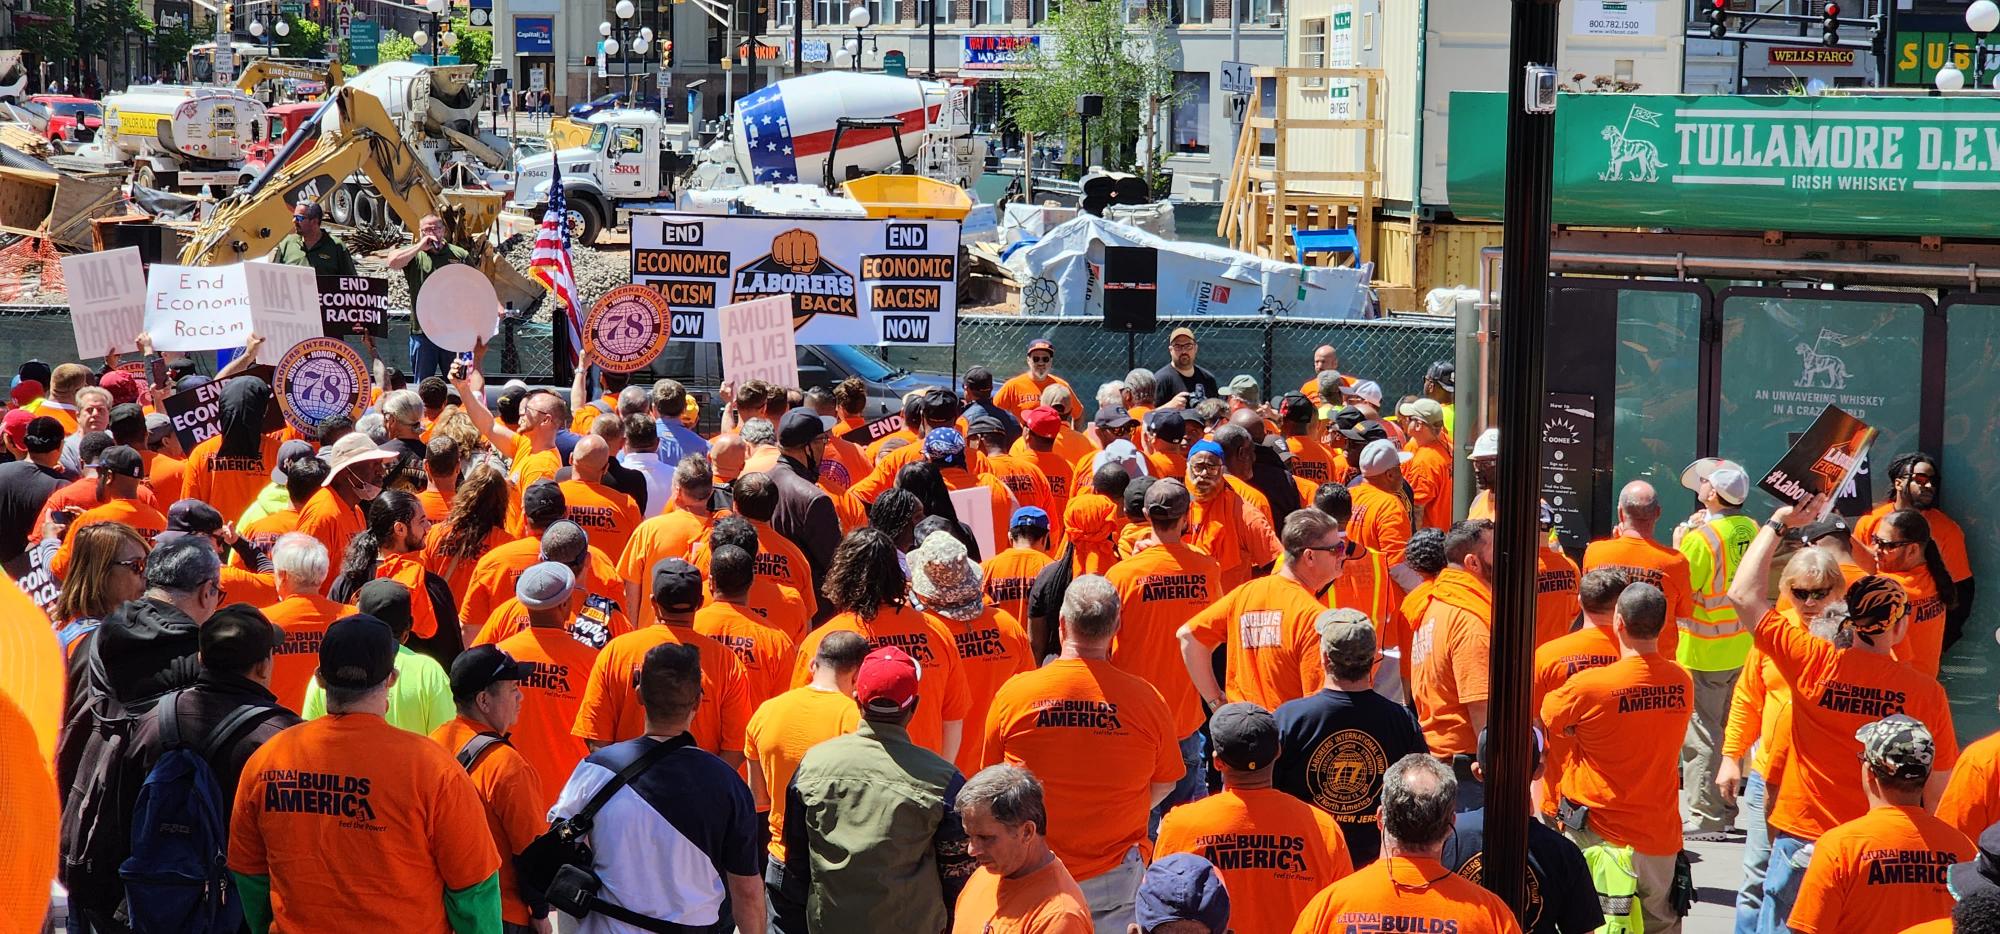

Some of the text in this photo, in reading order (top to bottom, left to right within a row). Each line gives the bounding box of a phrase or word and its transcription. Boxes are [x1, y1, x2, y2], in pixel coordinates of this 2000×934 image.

[1589, 20, 1639, 29] 800.782.1500
[738, 45, 779, 59] DNKIN'
[969, 37, 983, 50] WAY
[987, 37, 994, 50] IN
[1774, 50, 1855, 64] WELLS FARGO
[121, 118, 139, 128] TAYLOR
[1674, 122, 1904, 169] TULLAMORE
[528, 170, 548, 178] 93443
[614, 165, 640, 175] SRM
[297, 179, 321, 201] CAT
[1792, 175, 1908, 192] IRISH WHISKEY
[665, 225, 701, 243] END
[889, 227, 924, 247] END
[637, 252, 728, 274] ECONOMIC
[862, 257, 952, 279] ECONOMIC
[179, 273, 224, 289] End
[339, 277, 369, 291] END
[735, 272, 854, 297] LABORERS
[156, 293, 251, 311] Economic
[612, 294, 635, 305] HONOR
[800, 296, 855, 314] BACK
[873, 288, 938, 309] RACISM
[326, 309, 381, 324] RACISM
[604, 287, 662, 307] INTERNATIONAL
[661, 308, 669, 336] UNION
[175, 320, 244, 337] Racism
[607, 312, 645, 340] 78
[671, 314, 702, 335] OW
[885, 318, 928, 340] NOW
[621, 353, 640, 362] APRIL
[649, 332, 659, 348] 1903
[598, 358, 623, 371] North
[624, 348, 660, 370] America
[287, 350, 359, 394] JUSTICE HONOR STRENGTH
[303, 340, 366, 376] INTERNATIONAL
[358, 378, 369, 409] UNION
[301, 370, 341, 405] 78
[1755, 390, 1885, 407] AN UNWAVERING WHISKEY
[285, 392, 313, 425] ORGANIZED
[1773, 404, 1822, 417] IN A CRAZ
[1815, 459, 1842, 477] FIGHT
[572, 506, 613, 517] BUILDS
[568, 515, 616, 528] ERICA
[756, 552, 788, 565] UILDS
[754, 562, 791, 578] ERICA
[1547, 570, 1575, 581] BUILDS
[1163, 574, 1207, 586] BUILDS
[1538, 580, 1576, 594] MERICA
[1142, 583, 1209, 602] AMERICA
[877, 633, 928, 647] BUILDS
[953, 629, 1000, 645] BUILDS
[271, 640, 320, 655] AMER
[960, 640, 1006, 659] ERICA
[535, 662, 569, 677] ILDS
[518, 674, 570, 692] ERICA
[1641, 684, 1685, 698] BUILDS
[1617, 694, 1686, 714] AMERICA
[1851, 686, 1906, 704] BUILDS
[1064, 700, 1118, 714] BUILDS
[1036, 709, 1122, 731] AMERICA
[1335, 732, 1379, 755] INTERNATIONAL
[1375, 754, 1385, 775] UNION
[1333, 761, 1363, 785] 77
[298, 771, 371, 796] BUILDS
[264, 781, 376, 821] AMERICA
[1320, 798, 1340, 811] North
[1341, 796, 1371, 812] America
[338, 820, 387, 832] Feel the Power
[1336, 814, 1378, 824] NEW JERS
[1236, 834, 1305, 851] BUILDS
[1203, 845, 1307, 874] AMERICA
[1899, 850, 1958, 865] BUILDS
[1867, 859, 1948, 886] AMERIC
[1381, 914, 1459, 934] BUILDS
